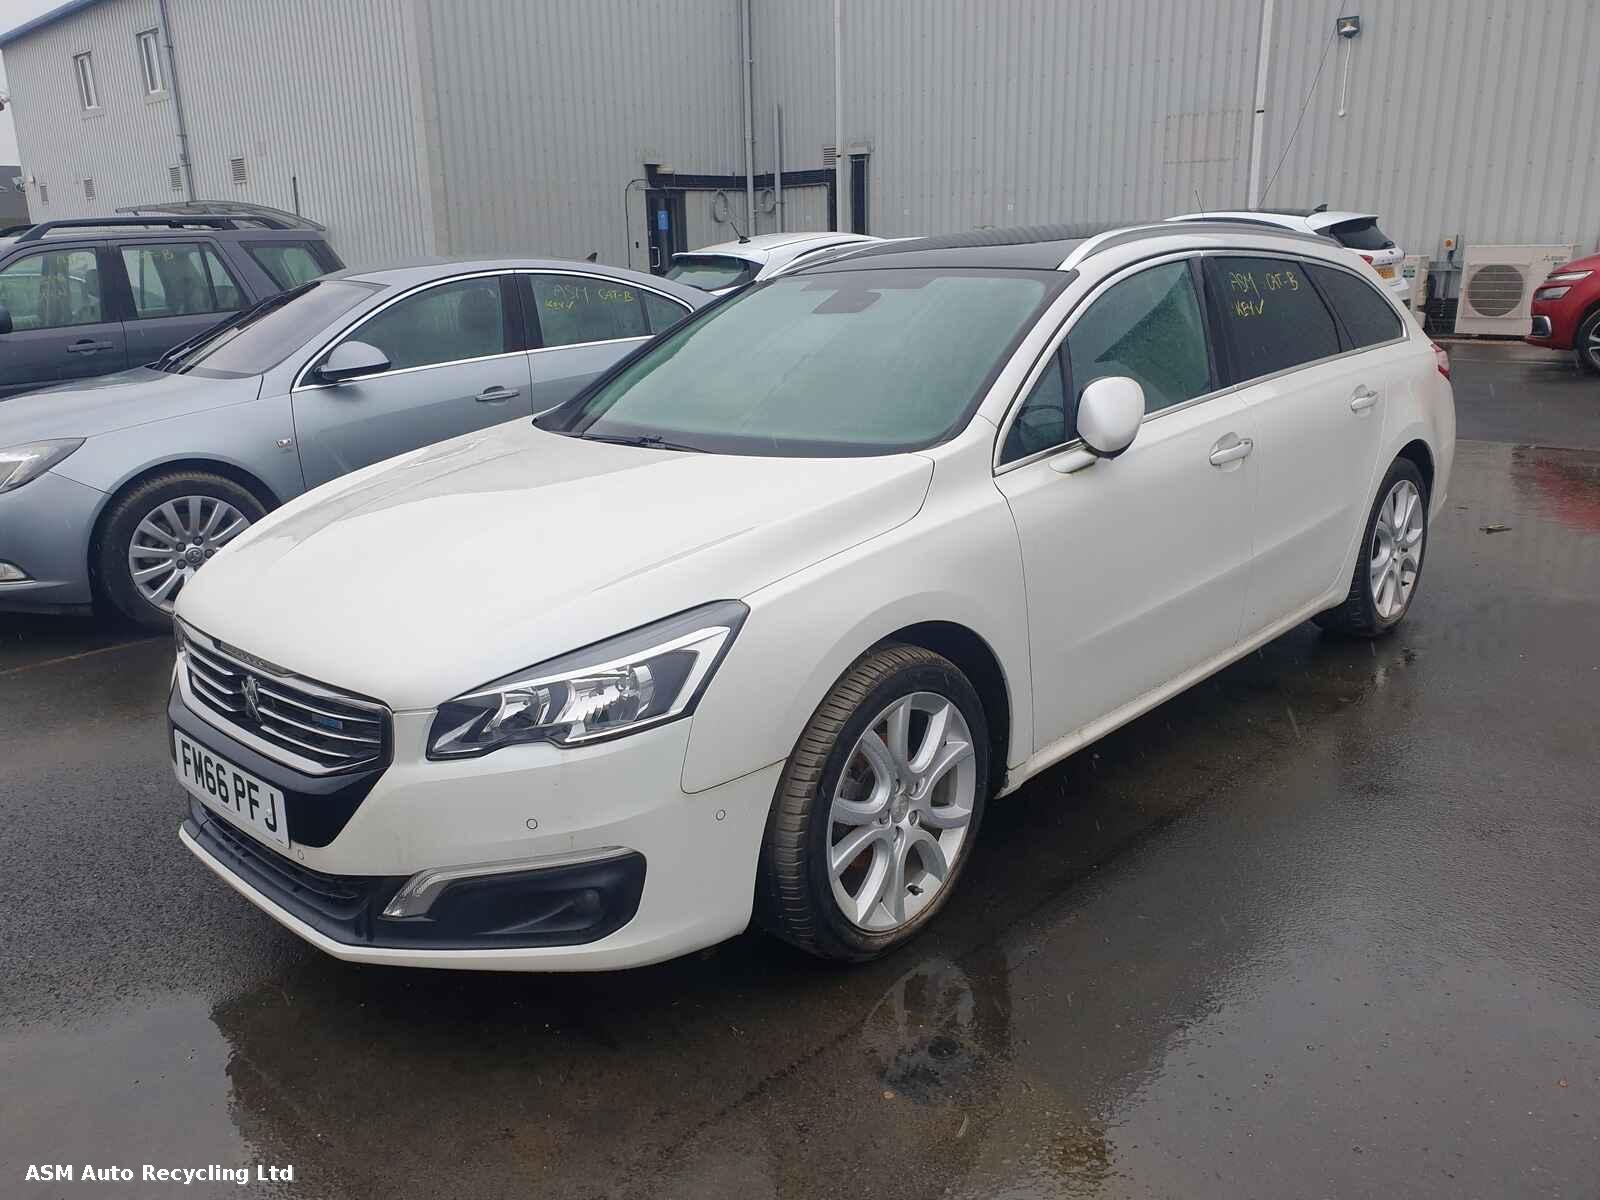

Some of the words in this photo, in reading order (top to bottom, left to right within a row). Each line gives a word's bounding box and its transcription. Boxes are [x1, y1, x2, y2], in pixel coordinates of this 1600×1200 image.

[1265, 271, 1299, 291] CAT-B
[181, 739, 230, 804] FM66
[233, 772, 278, 833] PFJ
